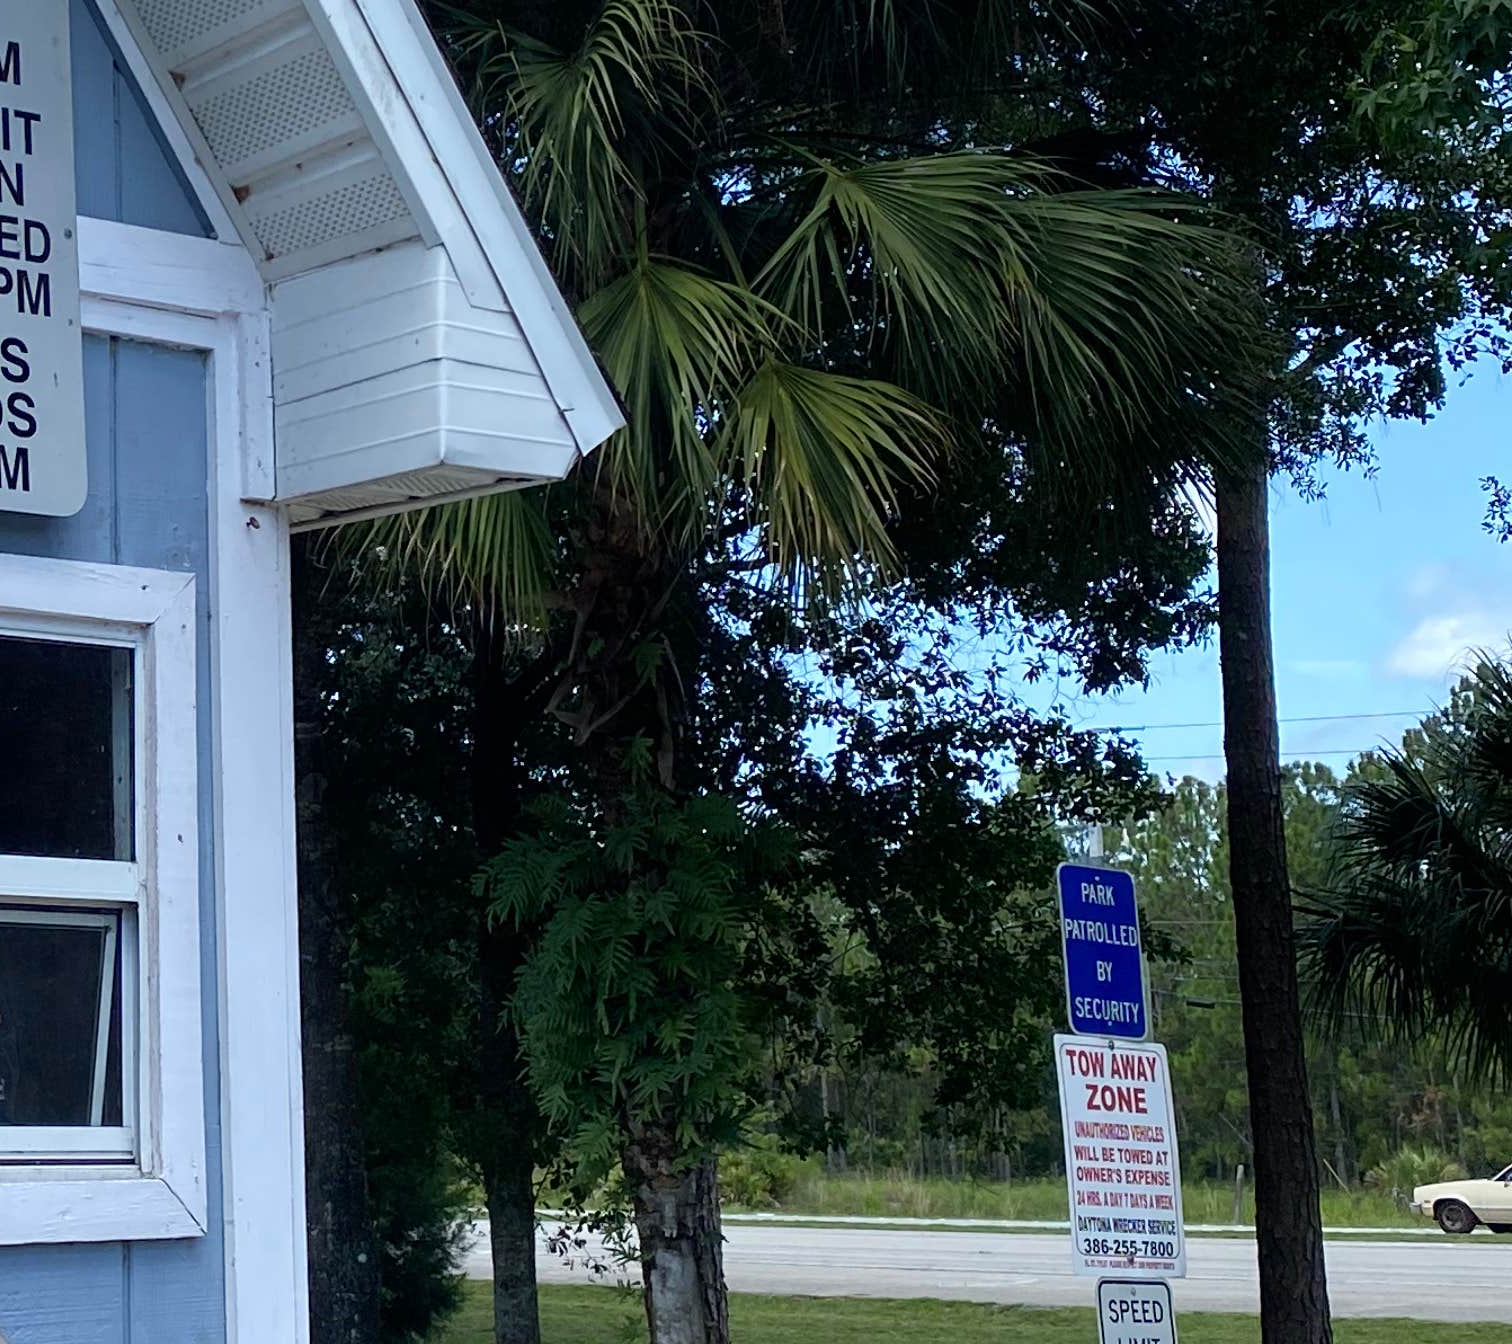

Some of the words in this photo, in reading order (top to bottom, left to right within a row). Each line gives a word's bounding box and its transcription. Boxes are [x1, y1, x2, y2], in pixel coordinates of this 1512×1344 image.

[1081, 882, 1115, 906] PARK
[1065, 918, 1138, 946] PATROLLED
[1096, 960, 1113, 983] BY
[1075, 996, 1139, 1024] SECURITY
[1066, 1049, 1104, 1078] TOW
[1111, 1053, 1157, 1083] AWAY
[1085, 1084, 1148, 1114] ZONE
[1074, 1145, 1099, 1162] WILL
[1101, 1147, 1116, 1163] BE
[1117, 1148, 1154, 1165] TOWED
[1156, 1151, 1169, 1166] AT
[1076, 1166, 1122, 1184] OWNER'S
[1125, 1169, 1171, 1186] EXPENSE
[1083, 1238, 1174, 1257] 386-255-7800
[1108, 1299, 1164, 1324] SPEED
